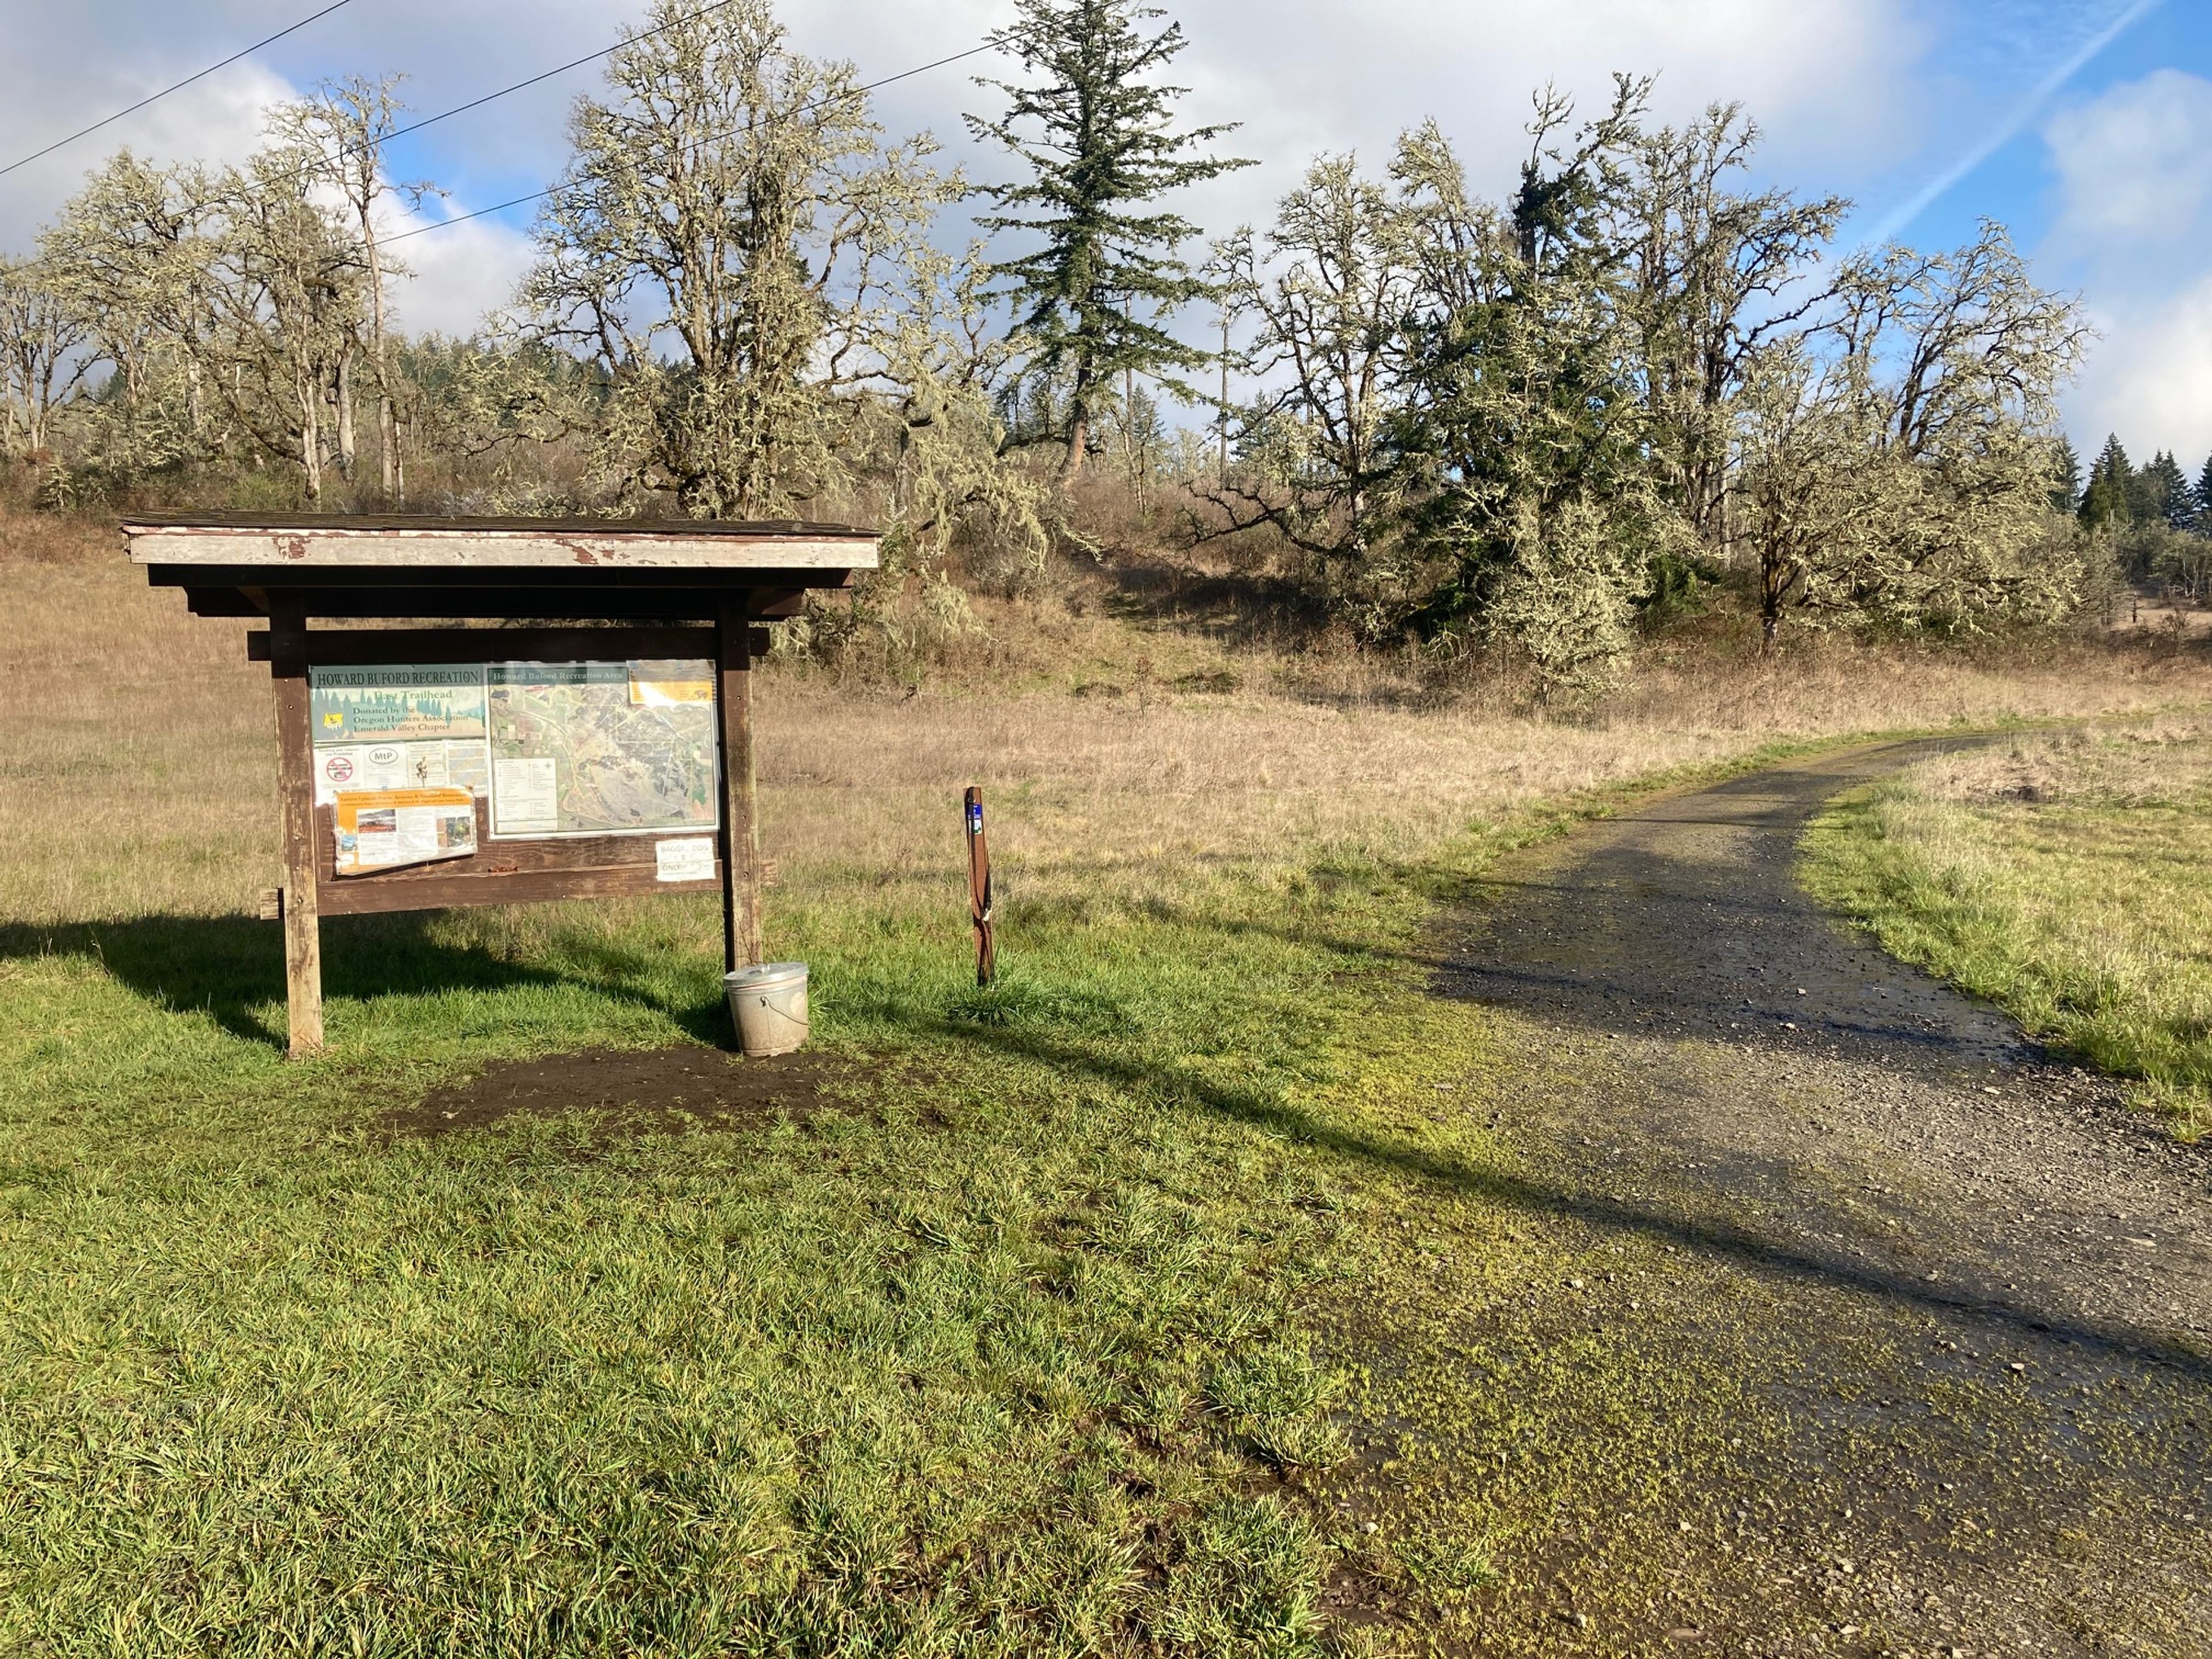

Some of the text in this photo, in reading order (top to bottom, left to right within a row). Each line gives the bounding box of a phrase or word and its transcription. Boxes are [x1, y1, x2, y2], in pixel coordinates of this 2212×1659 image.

[317, 671, 479, 685] HOWARD BUFORD RECREATION
[494, 672, 527, 681] Howard
[401, 691, 452, 699] Trailhead
[353, 716, 385, 724] Oregon
[418, 724, 450, 732] Chapter
